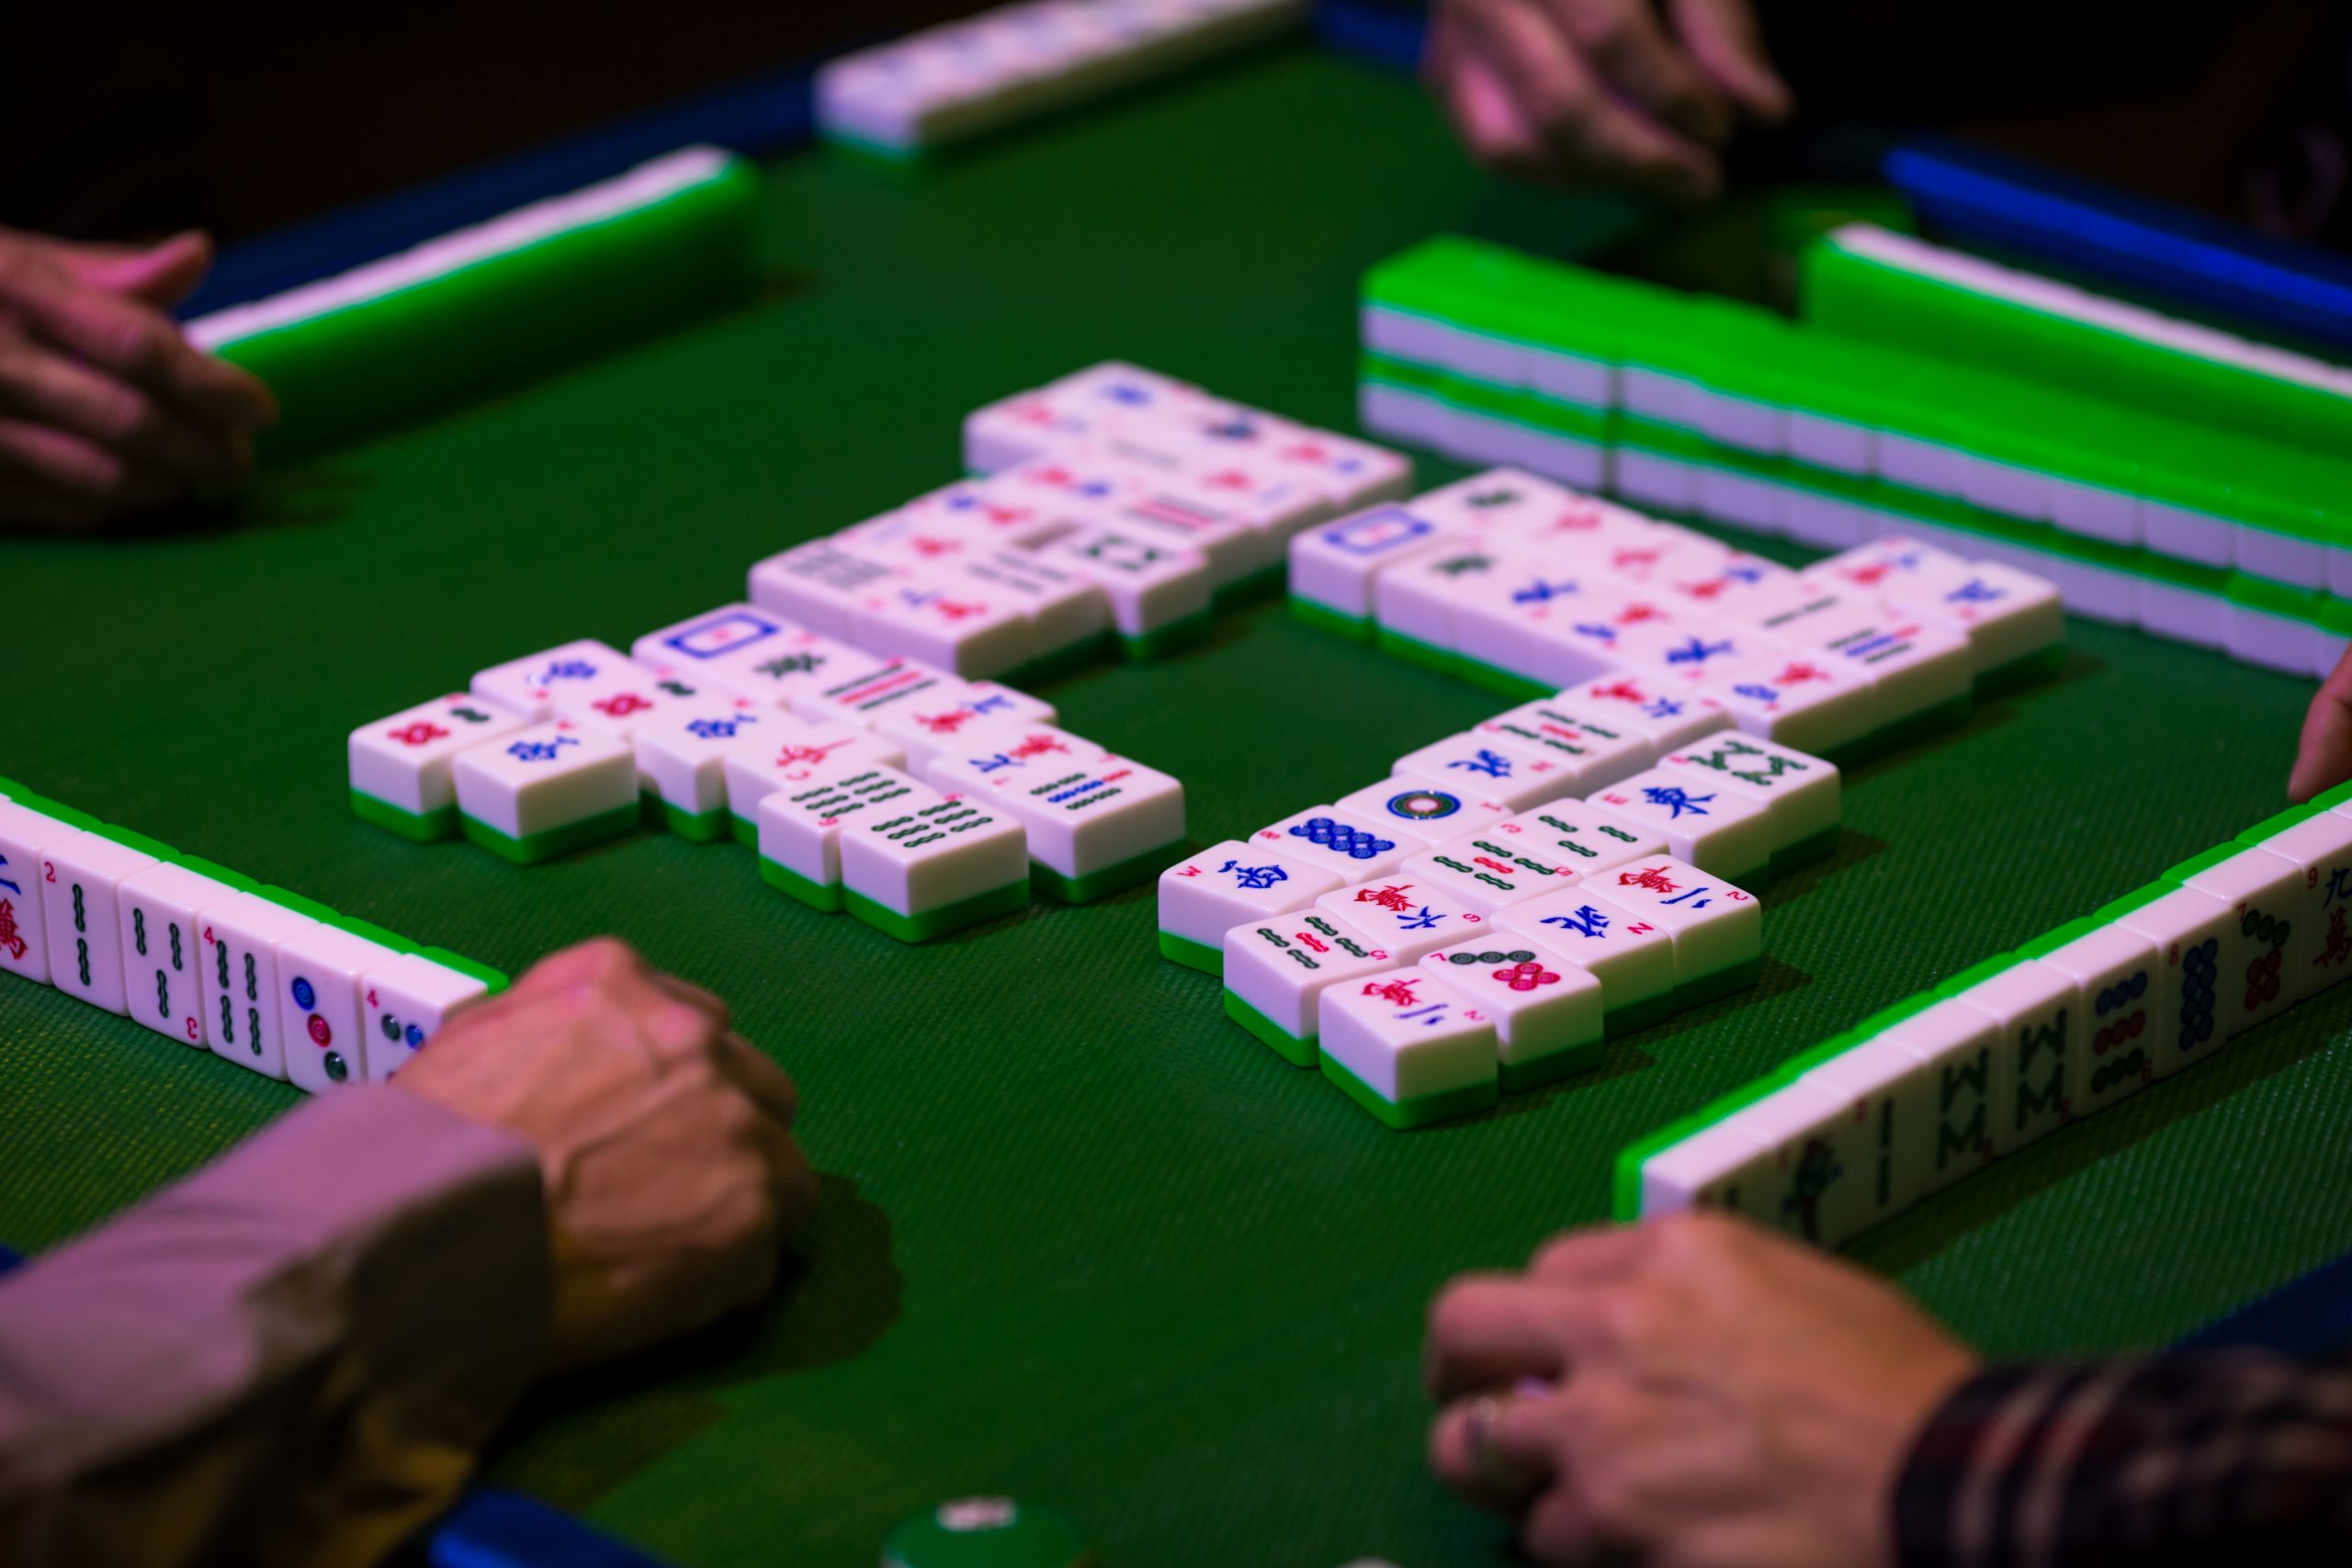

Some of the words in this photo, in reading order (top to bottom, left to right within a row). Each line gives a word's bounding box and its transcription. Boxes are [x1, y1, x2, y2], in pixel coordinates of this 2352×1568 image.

[1642, 786, 1718, 819] 東
[44, 861, 56, 883] 2
[1176, 865, 1203, 877] W
[1217, 860, 1288, 889] 西
[2308, 867, 2317, 889] 9
[1725, 890, 1748, 901] 2
[1539, 905, 1610, 939] 北
[1627, 921, 1654, 935] N
[204, 926, 216, 946] 4
[1430, 953, 1447, 962] 7
[366, 988, 379, 1009] 4
